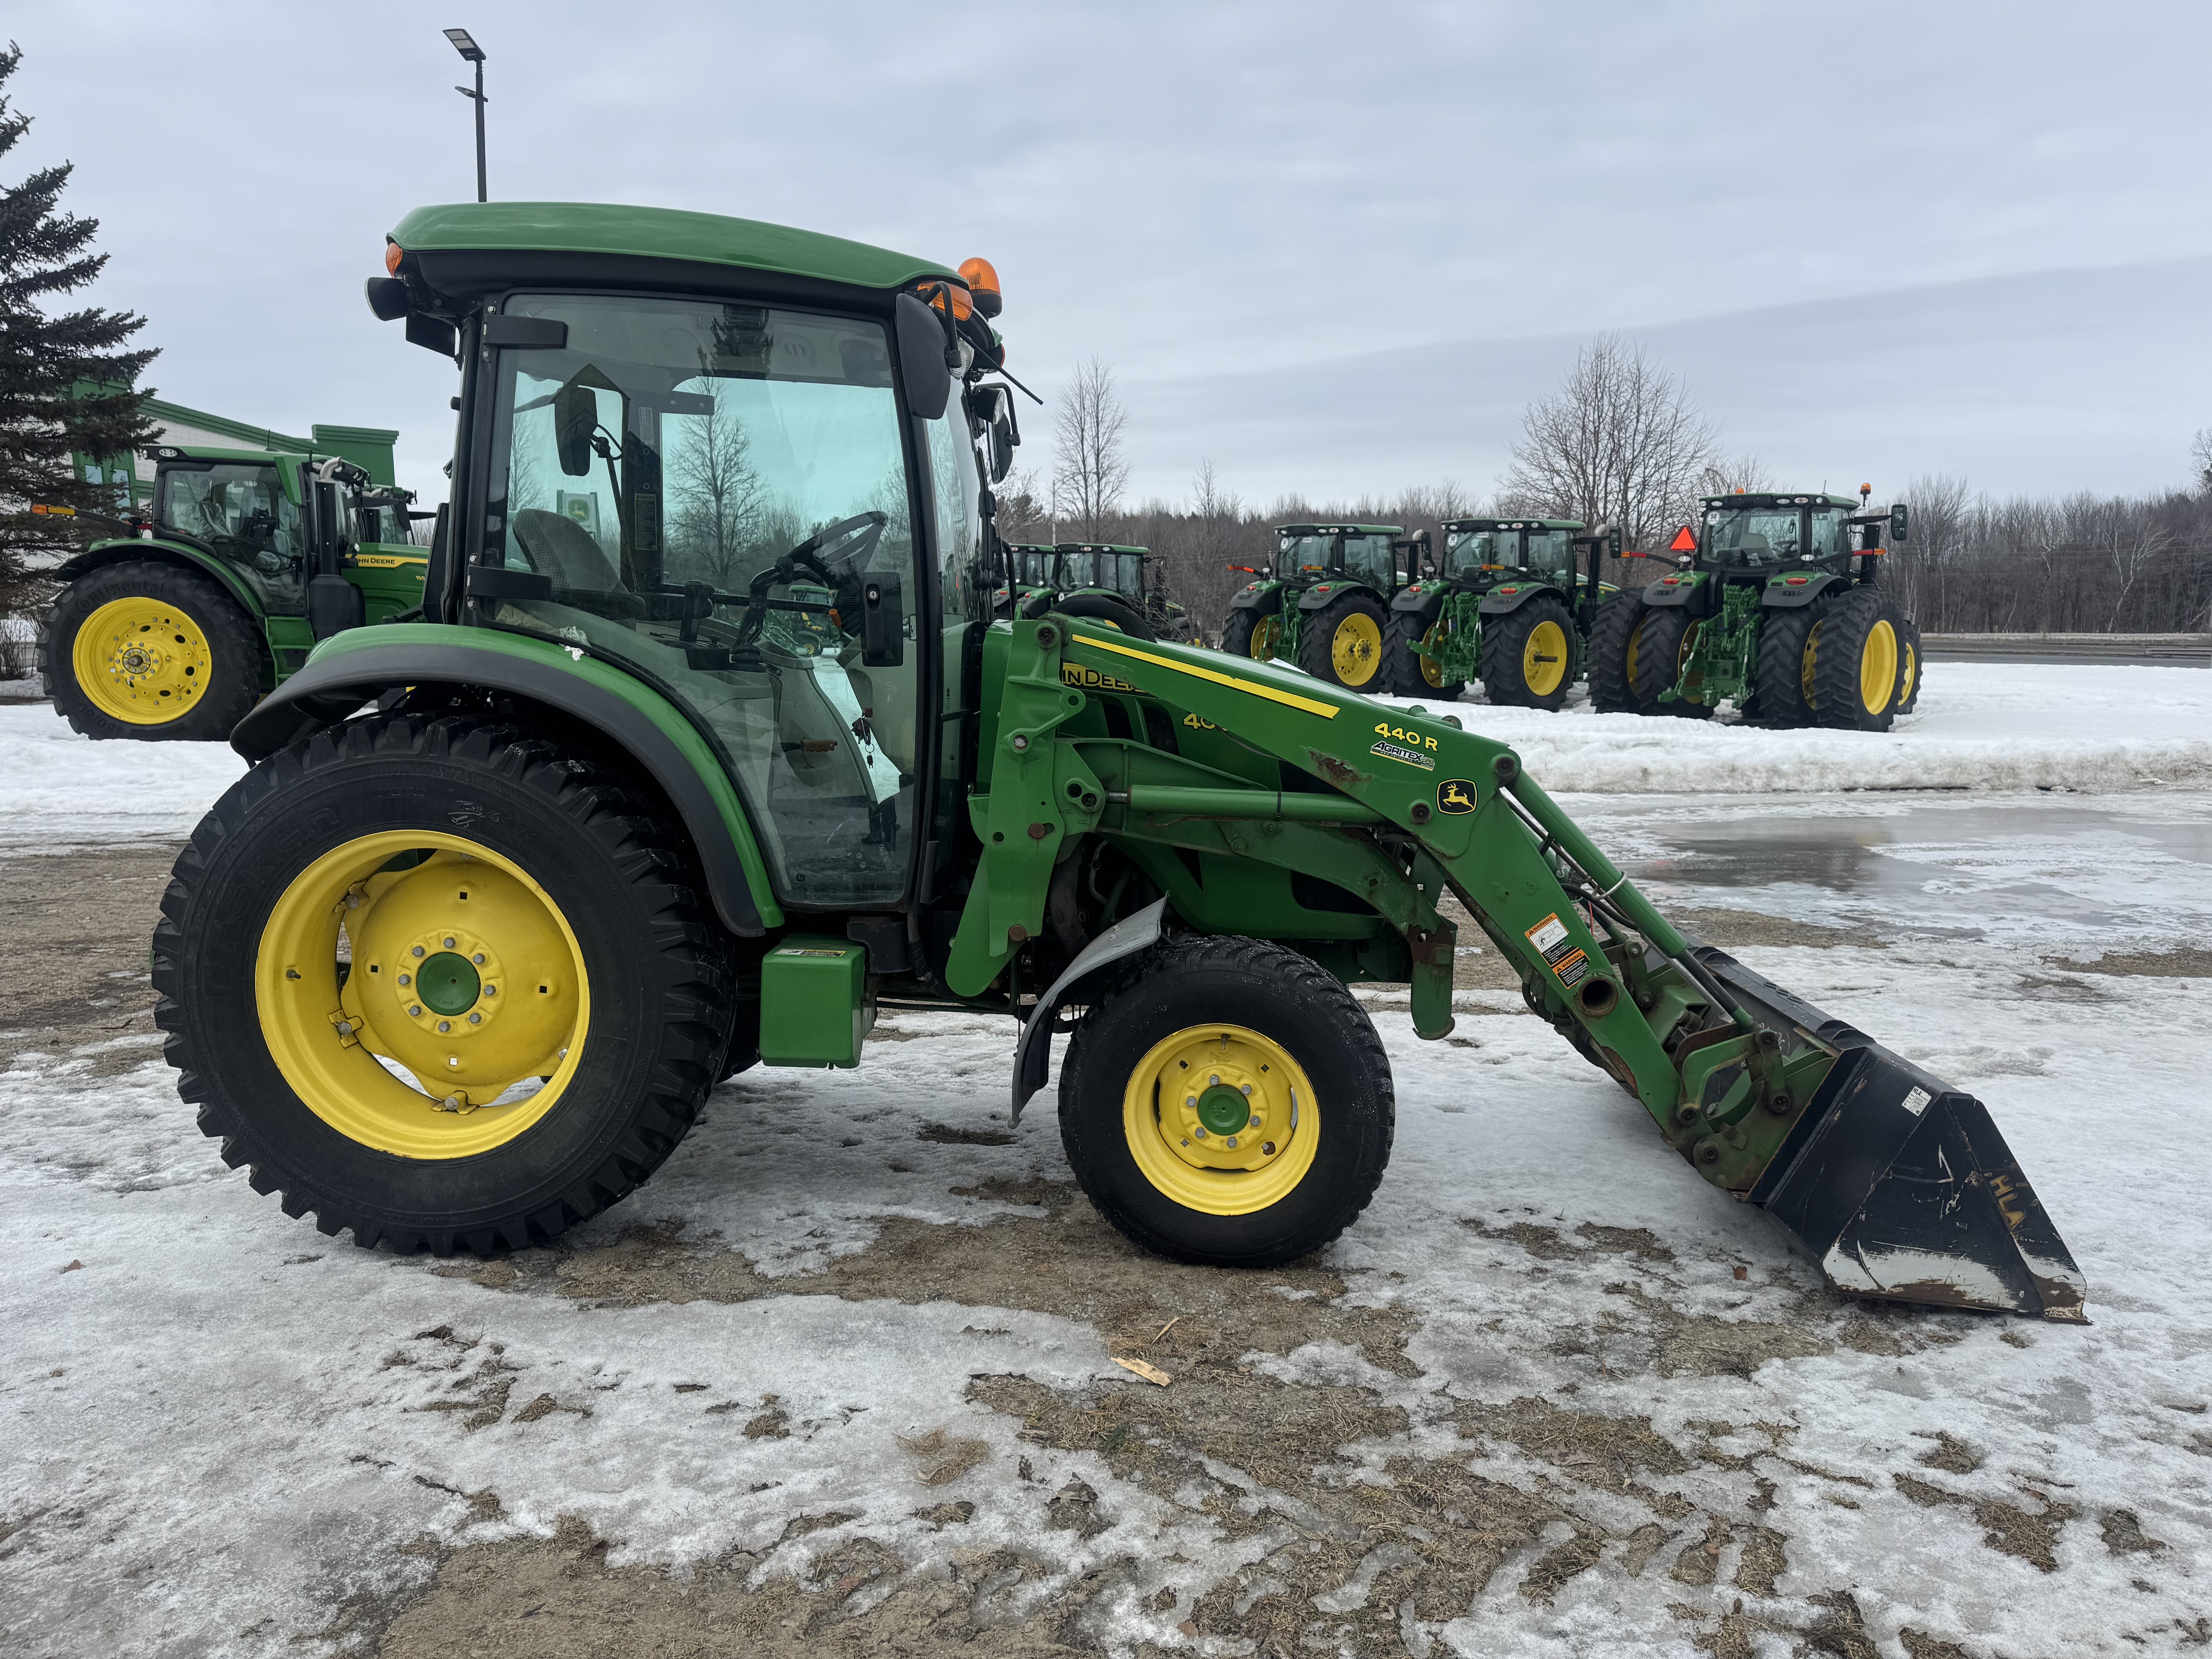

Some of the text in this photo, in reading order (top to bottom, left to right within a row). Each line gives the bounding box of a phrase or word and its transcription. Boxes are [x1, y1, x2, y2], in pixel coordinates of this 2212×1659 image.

[1375, 723, 1437, 752] 440 R
[1372, 742, 1424, 761] AGRITEX
[1532, 915, 1553, 932] WARNING
[1561, 952, 1582, 968] WARNING
[1913, 1087, 1922, 1096] HLA
[1989, 1175, 2026, 1228] HLA
